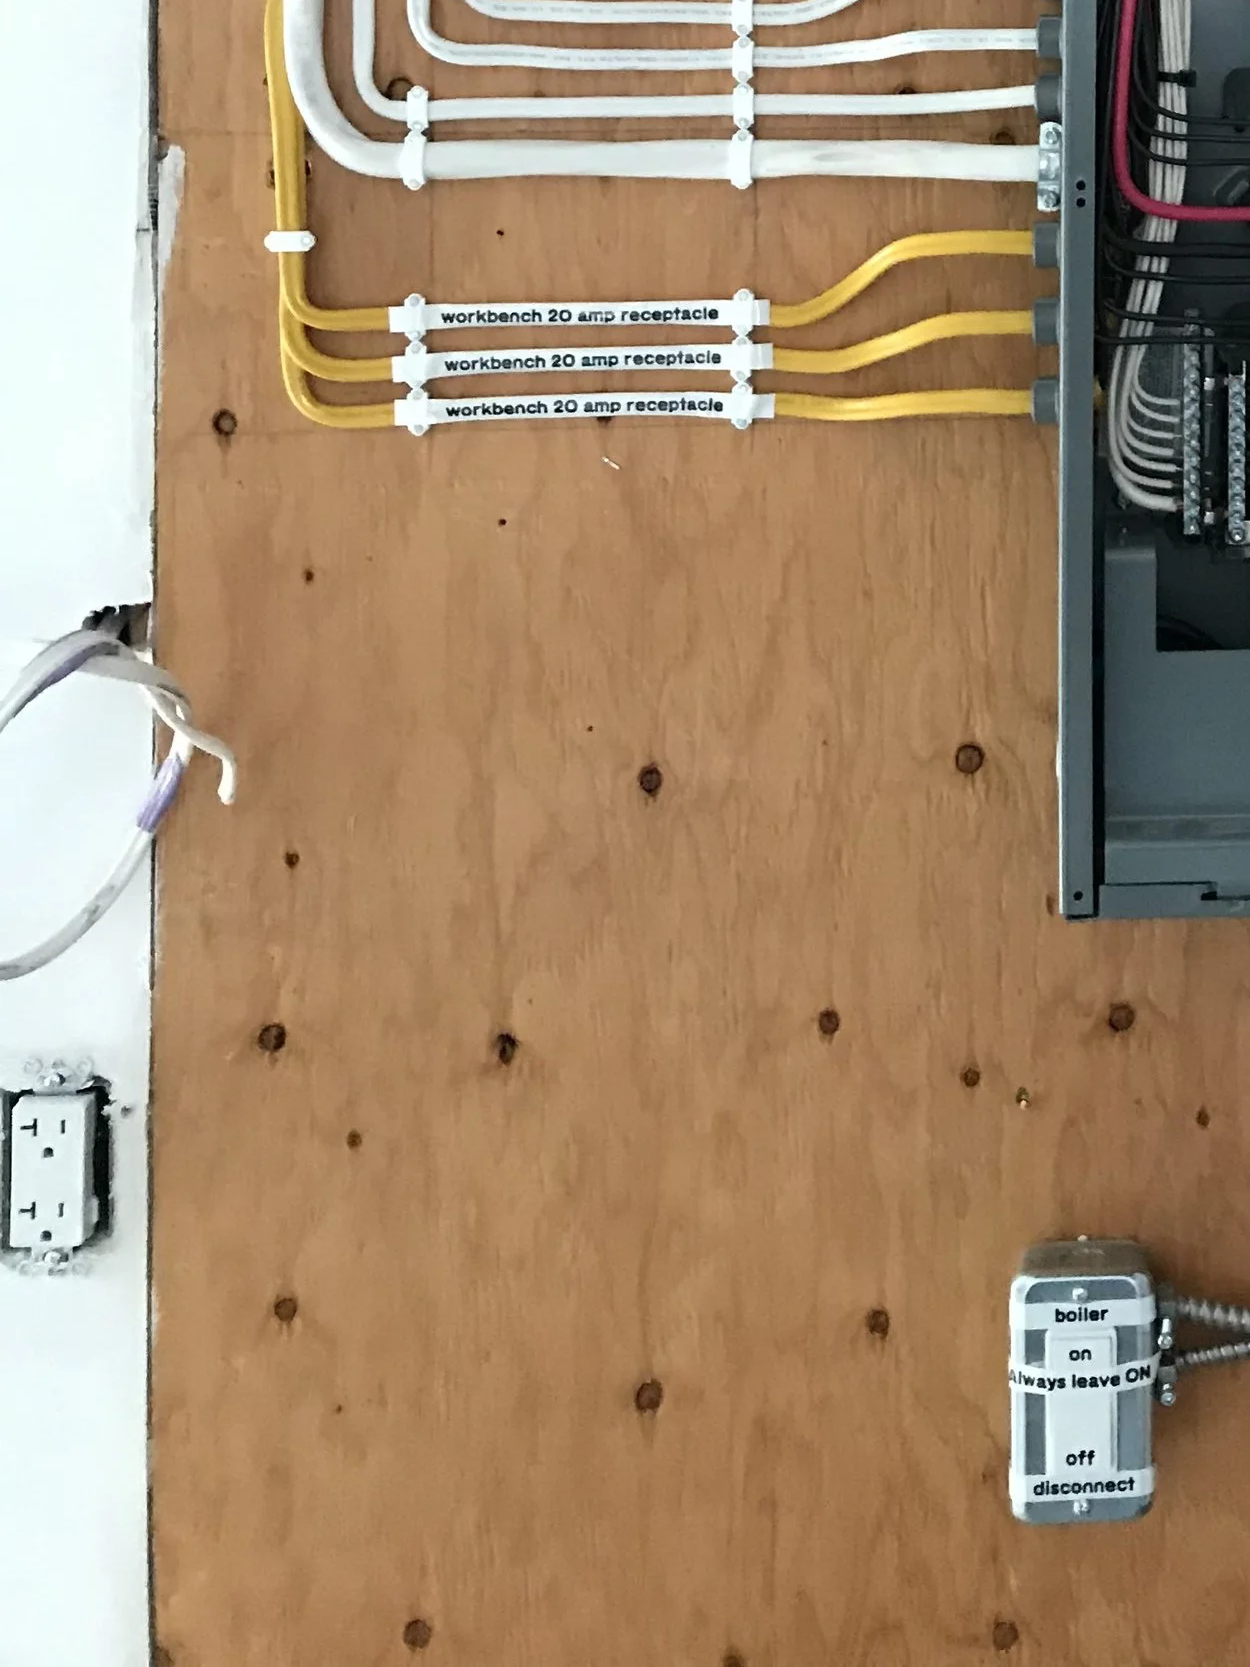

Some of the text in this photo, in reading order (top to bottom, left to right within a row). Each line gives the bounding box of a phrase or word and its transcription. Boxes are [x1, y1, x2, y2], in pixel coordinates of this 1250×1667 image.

[442, 307, 718, 326] workbench 20 amp receptacle
[445, 350, 721, 373] workbench 20 amp receptacle
[446, 397, 723, 416] workbench 20 amp receptacle
[1056, 1307, 1108, 1322] boiler
[1069, 1349, 1091, 1361] on
[1009, 1365, 1151, 1391] Always leave ON
[1066, 1450, 1095, 1465] off
[1034, 1477, 1135, 1495] disconnect
